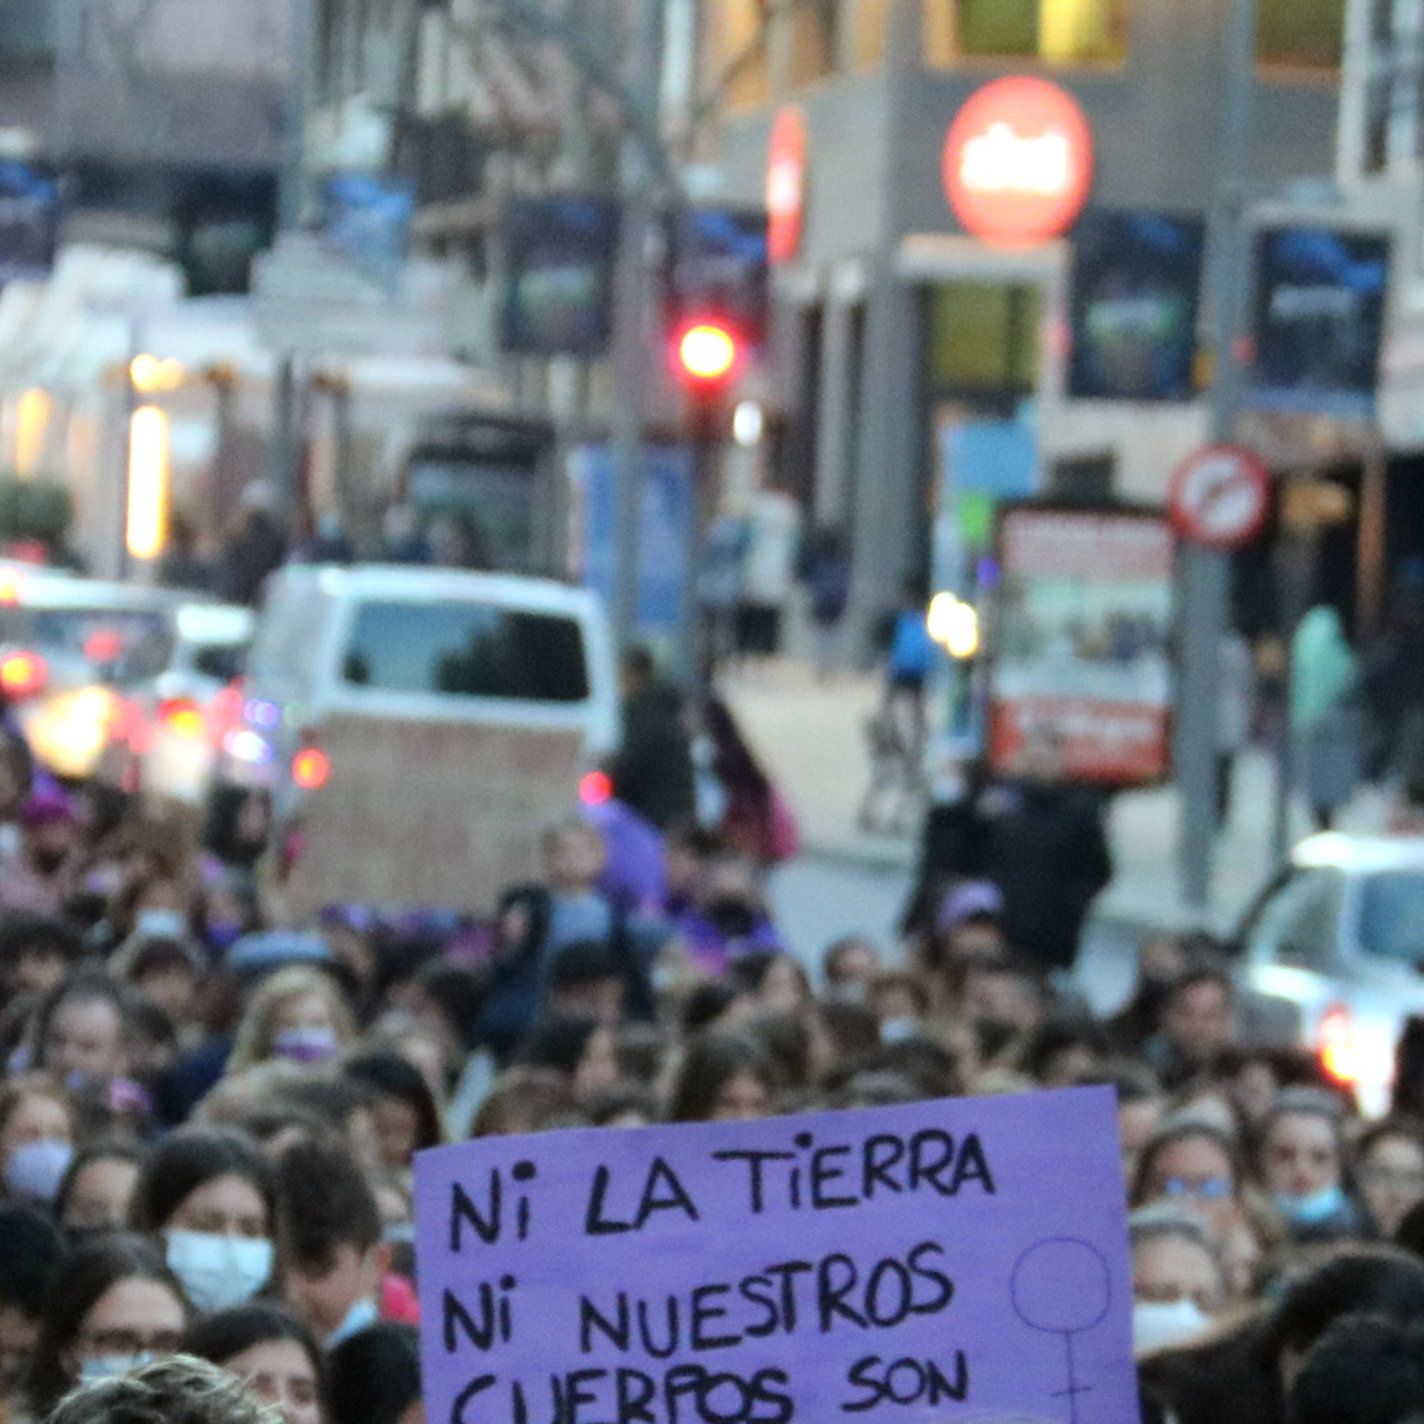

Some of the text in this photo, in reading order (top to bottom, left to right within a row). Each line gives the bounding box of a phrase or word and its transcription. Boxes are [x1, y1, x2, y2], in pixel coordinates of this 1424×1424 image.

[447, 1129, 997, 1252] Ni LA TiERRA
[443, 1240, 955, 1359] Ni NUESTROS
[841, 1349, 970, 1413] SON
